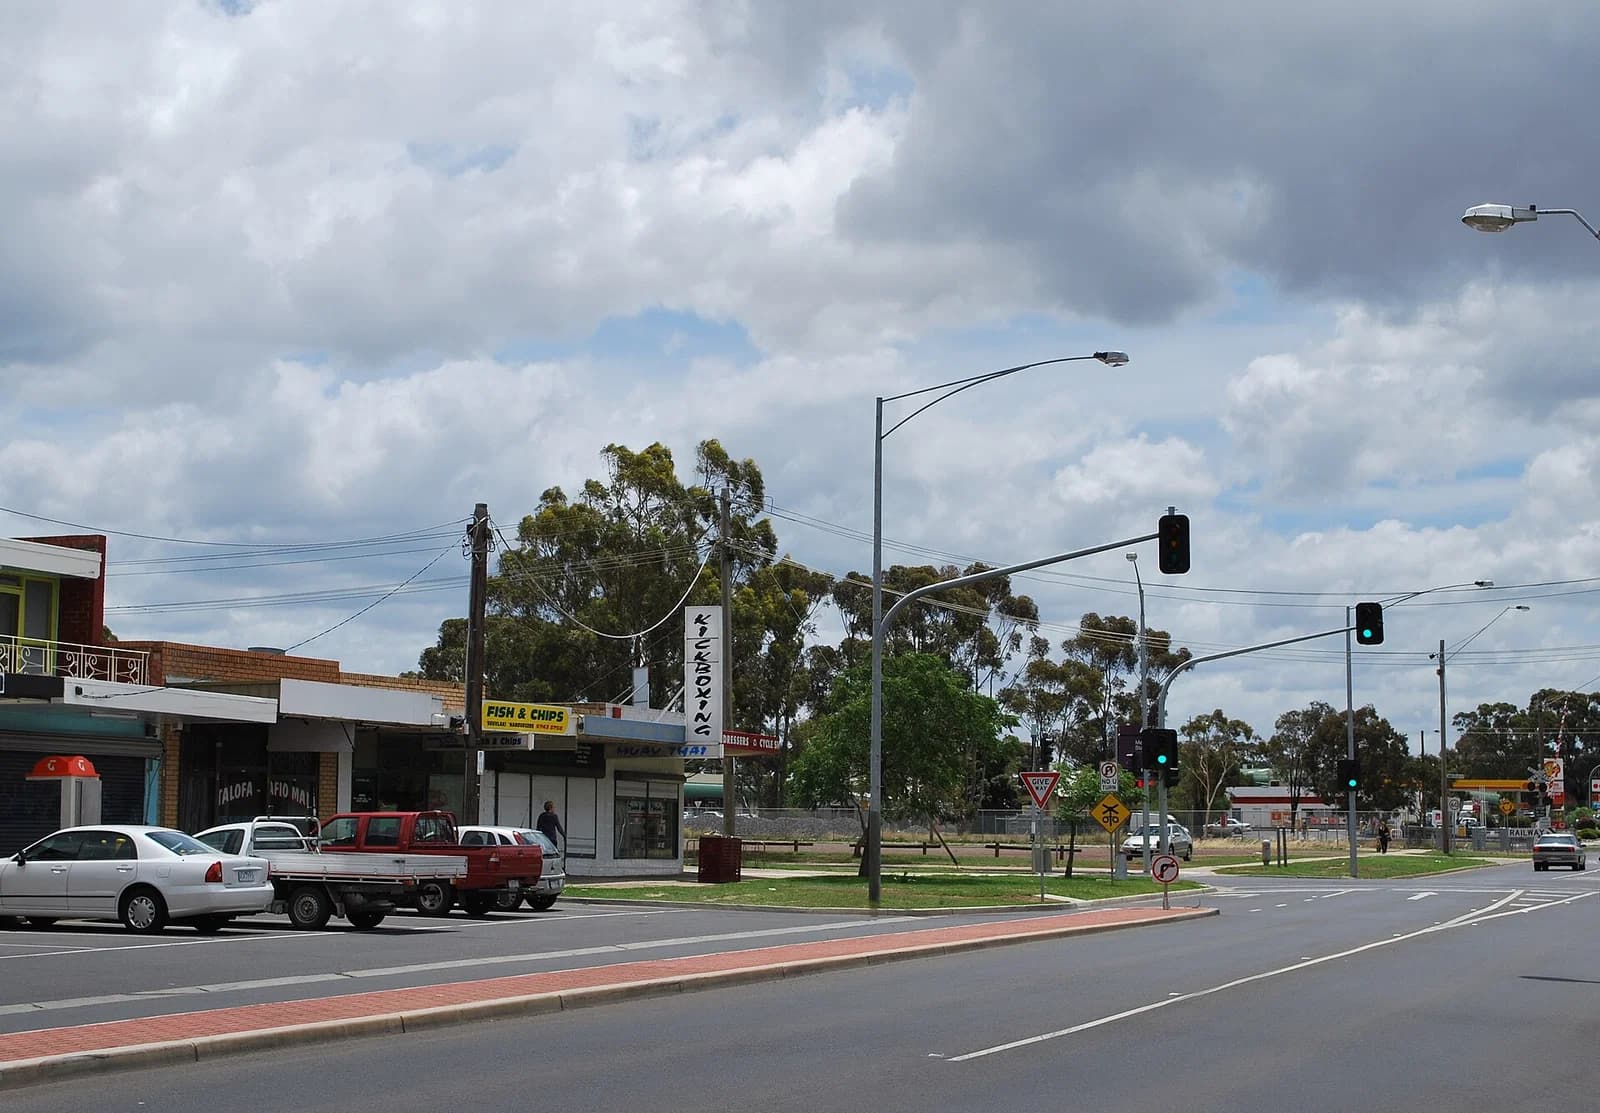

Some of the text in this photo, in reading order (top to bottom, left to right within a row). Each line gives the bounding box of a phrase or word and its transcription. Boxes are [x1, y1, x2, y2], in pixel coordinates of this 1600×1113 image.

[694, 613, 712, 736] KICKBOXING
[487, 706, 564, 722] FISH & CHIPS
[501, 735, 522, 746] Chips
[760, 738, 774, 749] CYCLE
[1509, 828, 1545, 837] RAILWAY
